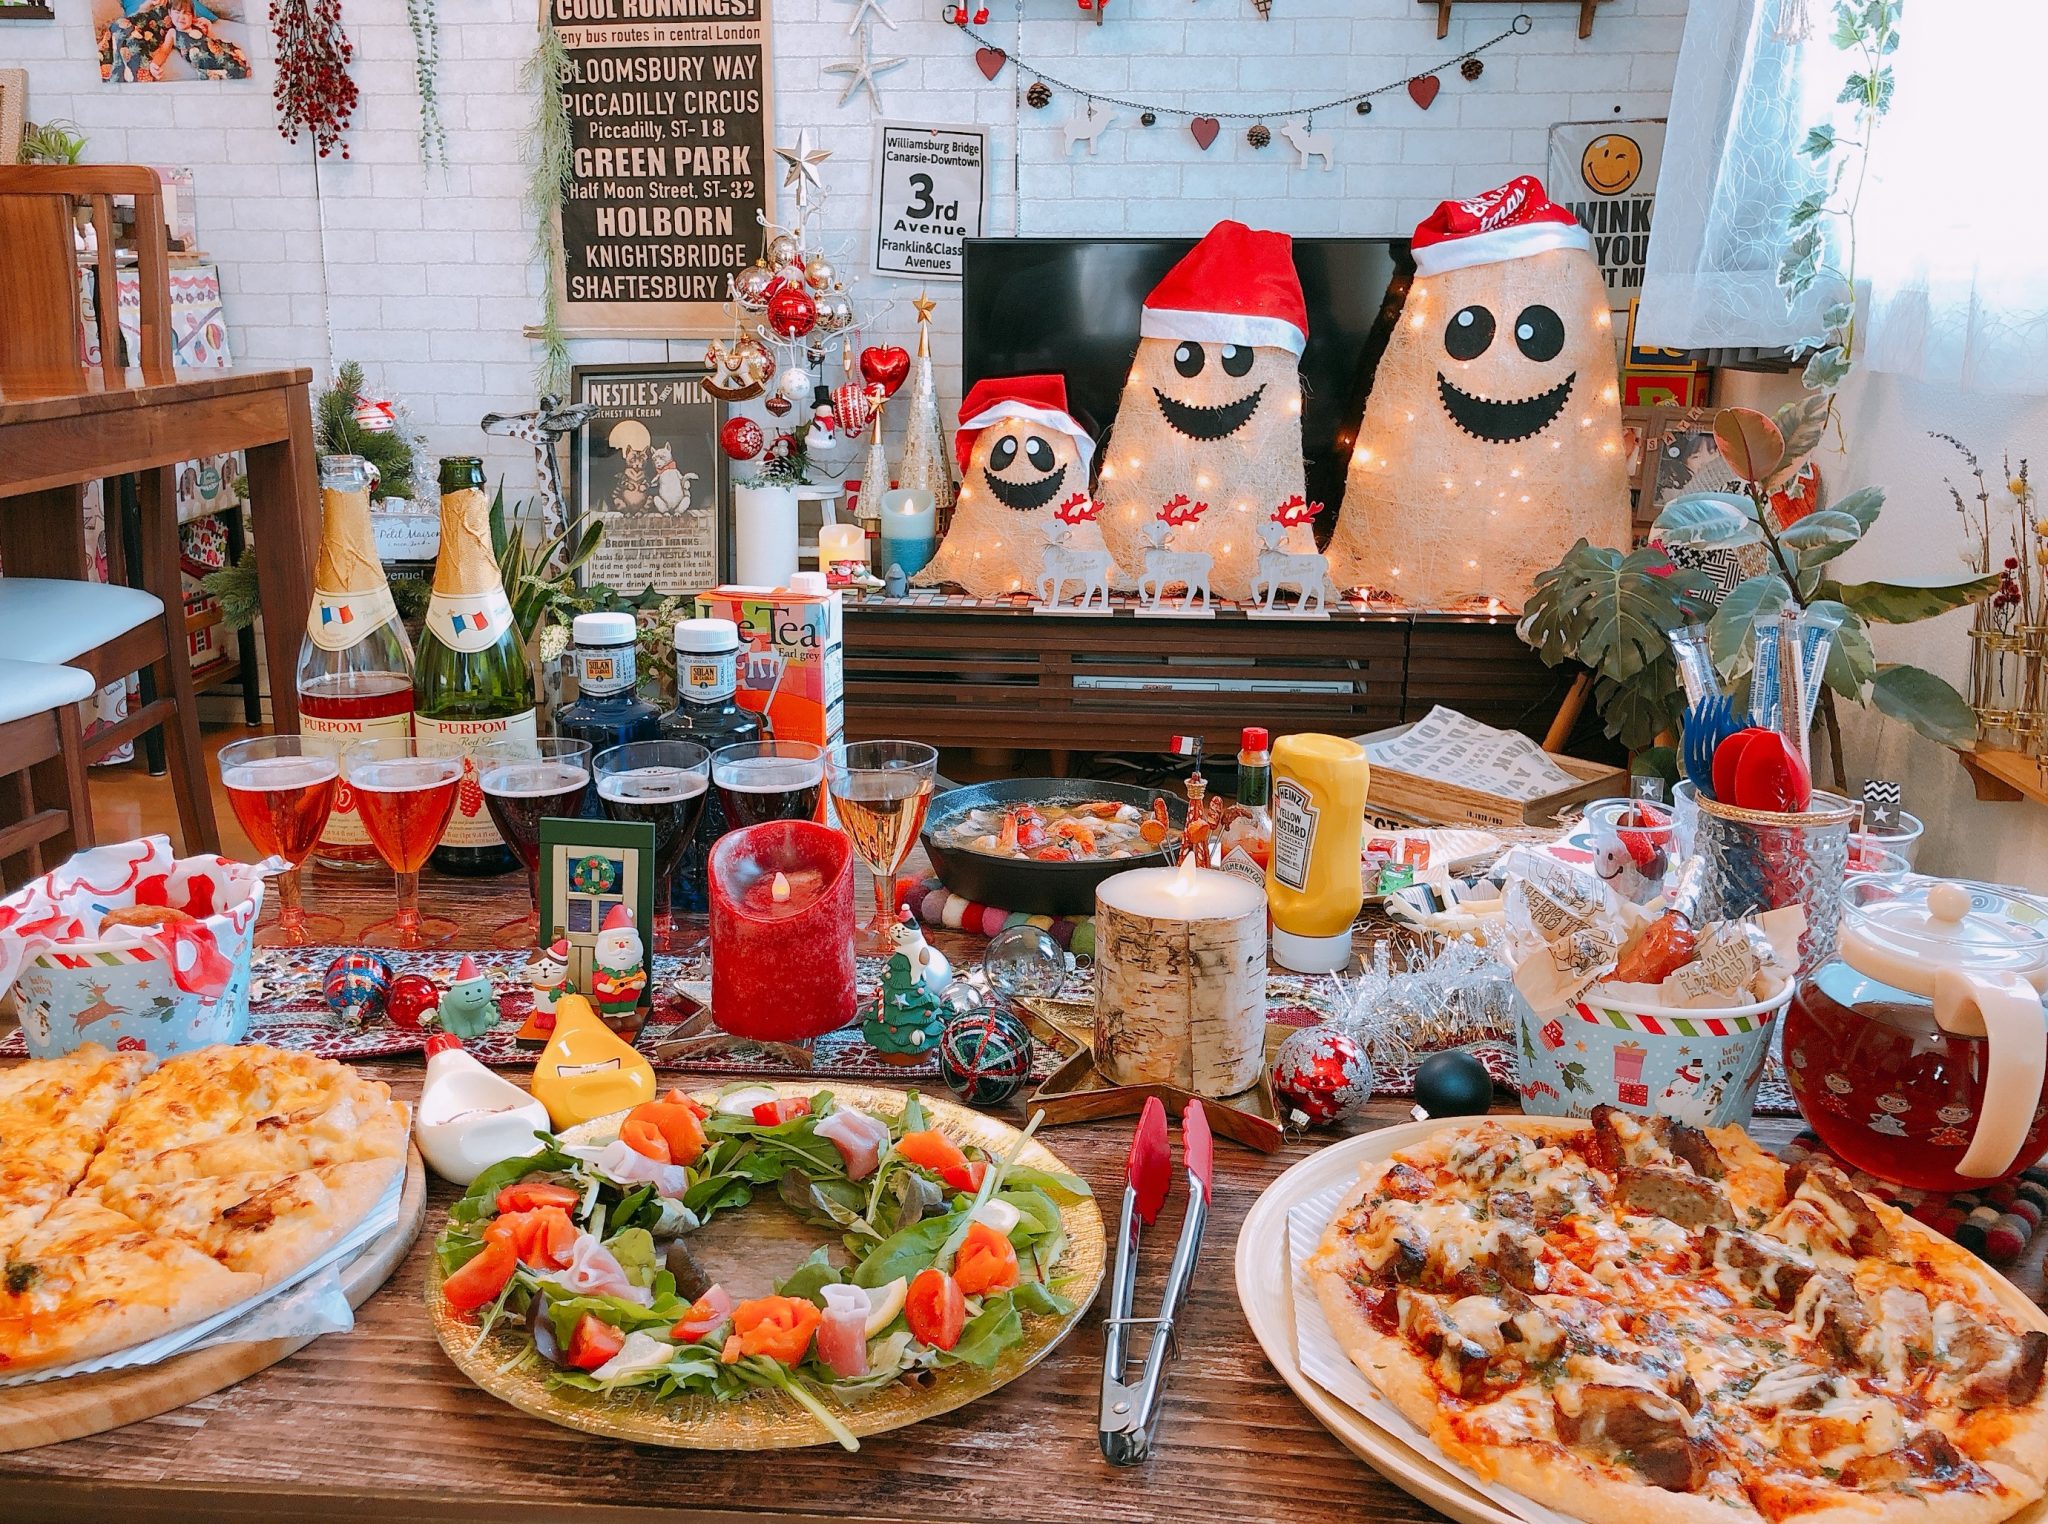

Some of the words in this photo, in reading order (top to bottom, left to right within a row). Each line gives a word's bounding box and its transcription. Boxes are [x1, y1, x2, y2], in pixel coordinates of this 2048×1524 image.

[586, 29, 607, 43] bus
[612, 28, 650, 42] routes
[654, 27, 664, 40] in
[670, 26, 713, 41] central
[716, 25, 761, 40] London
[561, 57, 705, 84] BLOOMSBURY
[712, 55, 757, 81] WAY
[564, 92, 677, 117] PICCADILLY
[684, 90, 760, 114] CIRCUS
[589, 120, 666, 142] Piccadilly,
[887, 137, 950, 154] Williamsburg
[952, 142, 980, 156] Bridge
[575, 147, 666, 177] GREEN
[675, 146, 752, 176] PARK
[886, 151, 980, 168] Canarsie-Downtown
[569, 182, 599, 200] Half
[603, 182, 643, 200] Moon
[650, 181, 699, 200] Street,
[596, 207, 733, 237] HOLBORN
[1565, 199, 1653, 234] WINK
[894, 220, 967, 236] Avenue
[586, 244, 747, 269] KNIGHTSBRIDGE
[904, 256, 952, 270] Avenues
[572, 275, 718, 300] SHAFTESBURY
[594, 409, 622, 419] ICHEST
[625, 409, 634, 418] IN
[636, 408, 662, 417] CREAM
[605, 539, 636, 548] BROWN
[592, 571, 605, 580] And
[633, 571, 653, 579] sound
[654, 570, 661, 578] in
[679, 569, 692, 577] and
[600, 562, 612, 570] did
[649, 563, 660, 572] my
[683, 560, 697, 568] like
[626, 580, 646, 588] drink
[671, 579, 687, 587] milk
[754, 606, 820, 648] Tea
[778, 647, 797, 659] Earl
[799, 651, 821, 663] grey
[304, 717, 364, 733] PURPOM
[438, 720, 508, 734] PURPOM
[1280, 788, 1303, 807] HEINZ
[1279, 807, 1302, 824] YELLOW
[1276, 817, 1306, 839] MUSTARD
